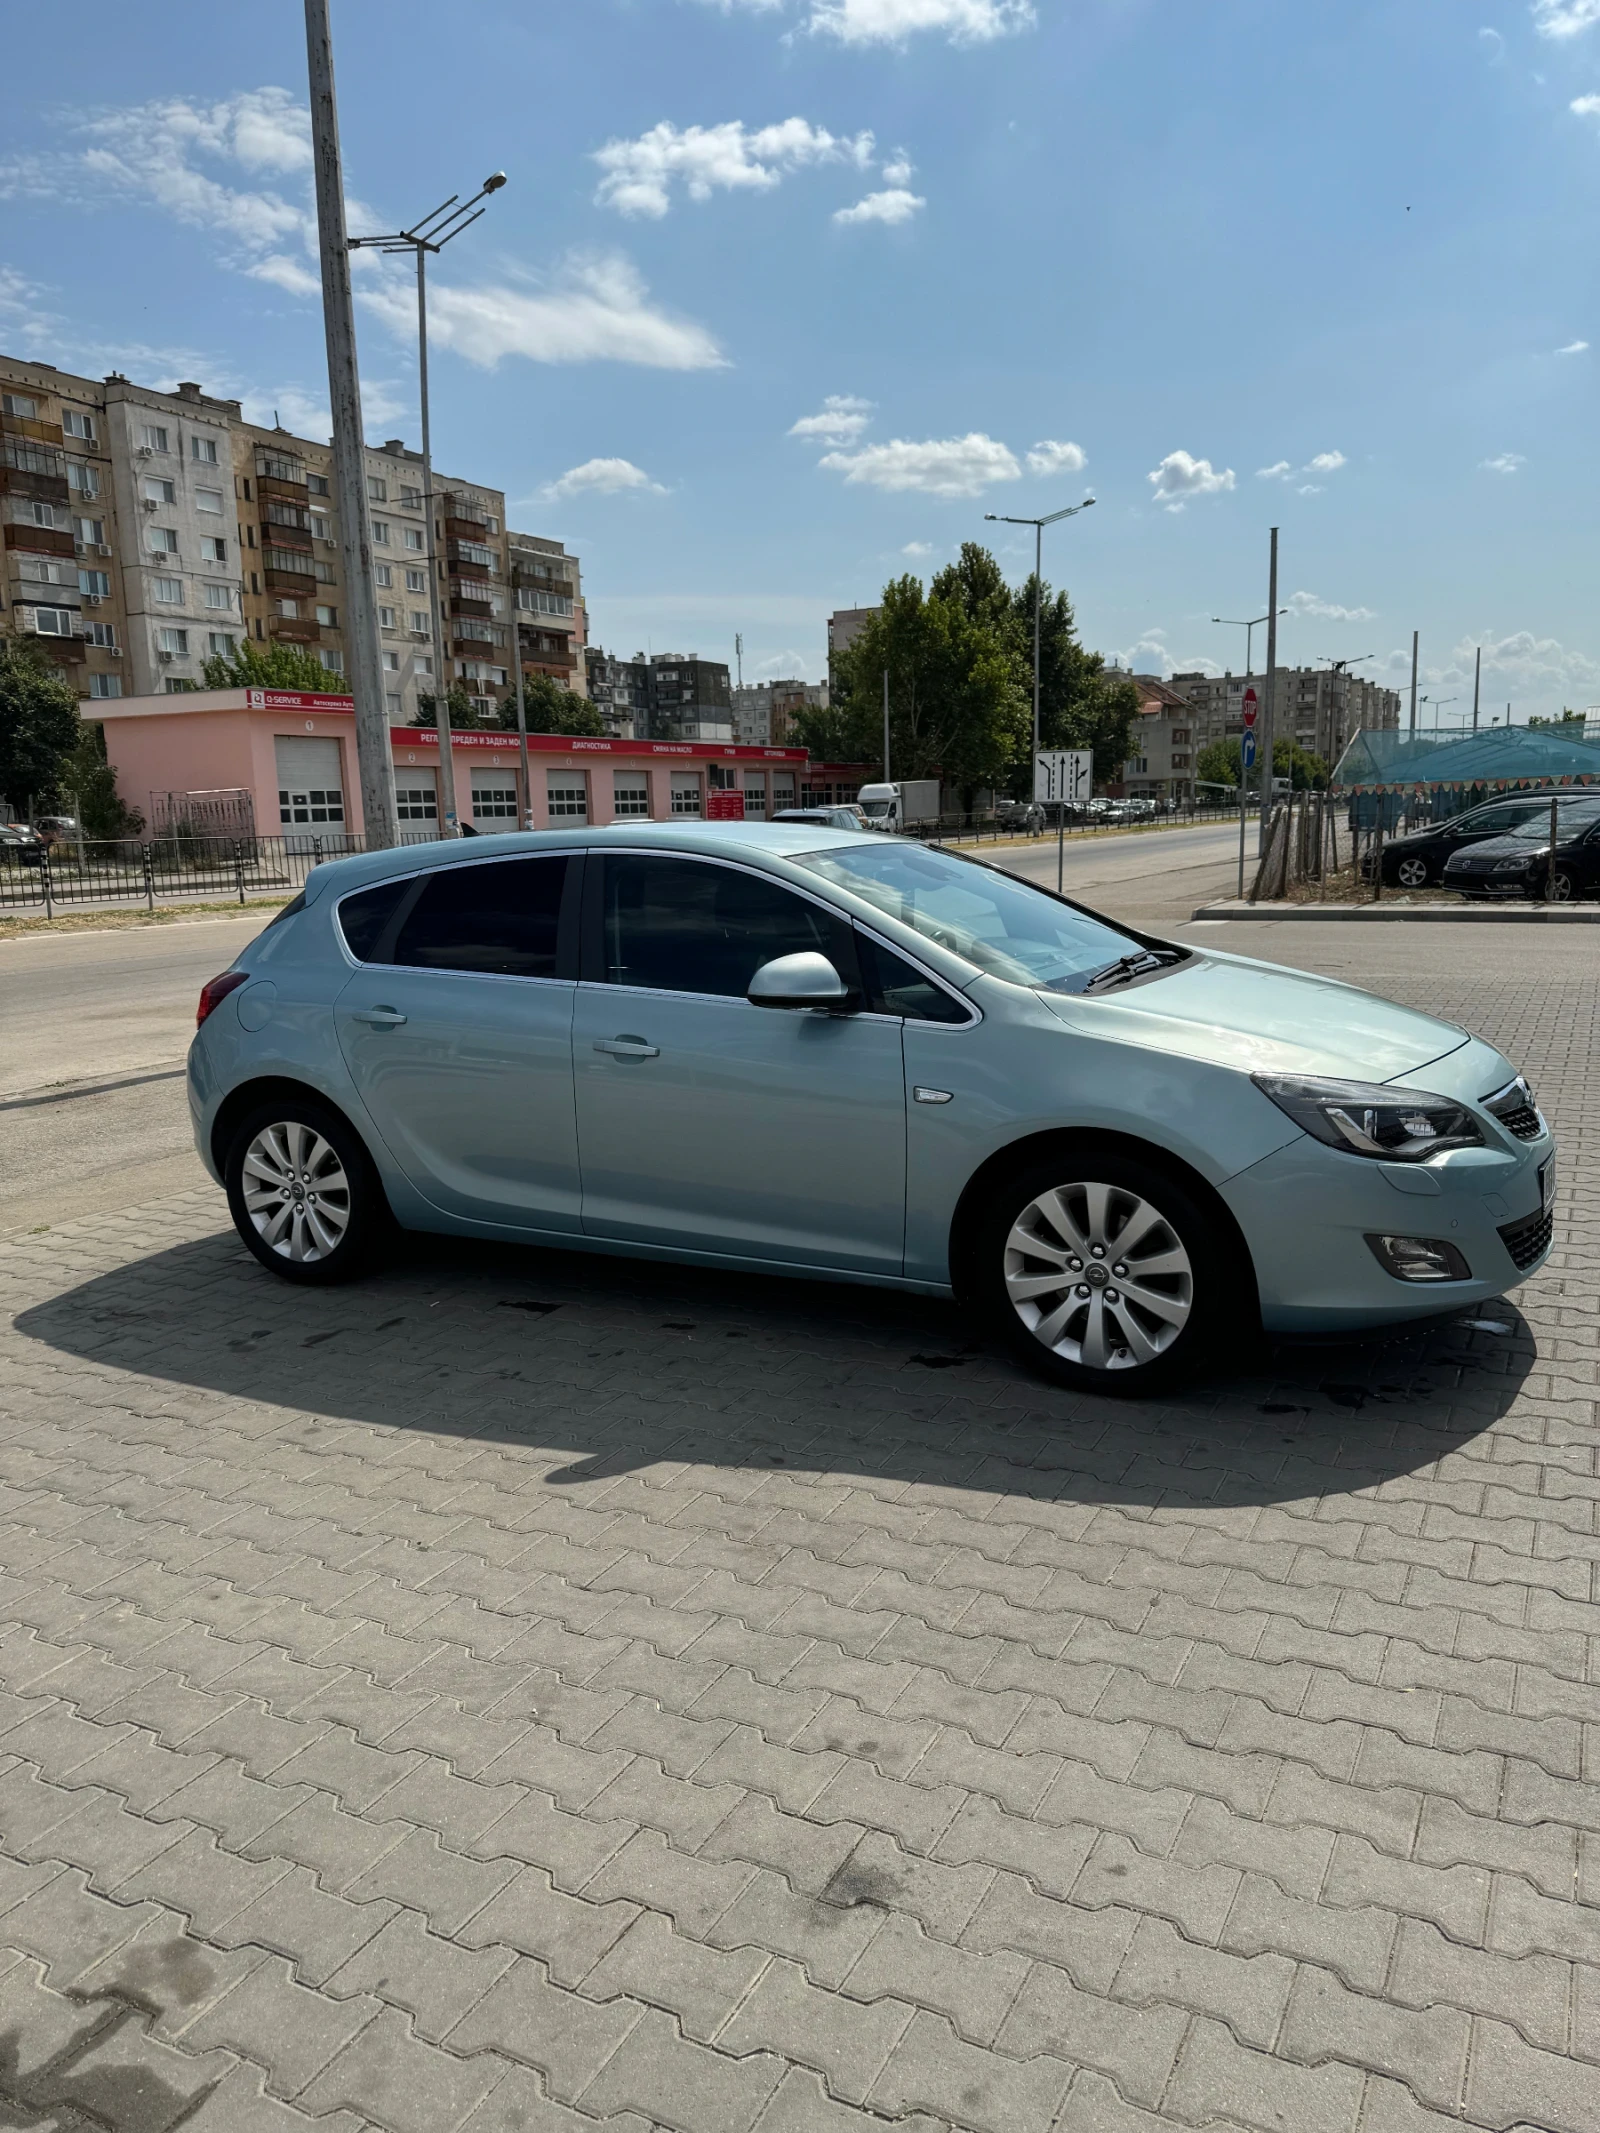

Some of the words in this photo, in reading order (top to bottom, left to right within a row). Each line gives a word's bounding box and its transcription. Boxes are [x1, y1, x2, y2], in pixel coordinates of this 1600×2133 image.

[266, 695, 302, 705] Q-SERVICE
[1244, 700, 1257, 715] STOP
[420, 733, 439, 743] РЕГЛ
[451, 735, 478, 745] ПРЕДЕН
[479, 736, 485, 745] И
[486, 737, 507, 747] ЗАДЕН
[572, 741, 611, 750] ДИАГНОСТИКА
